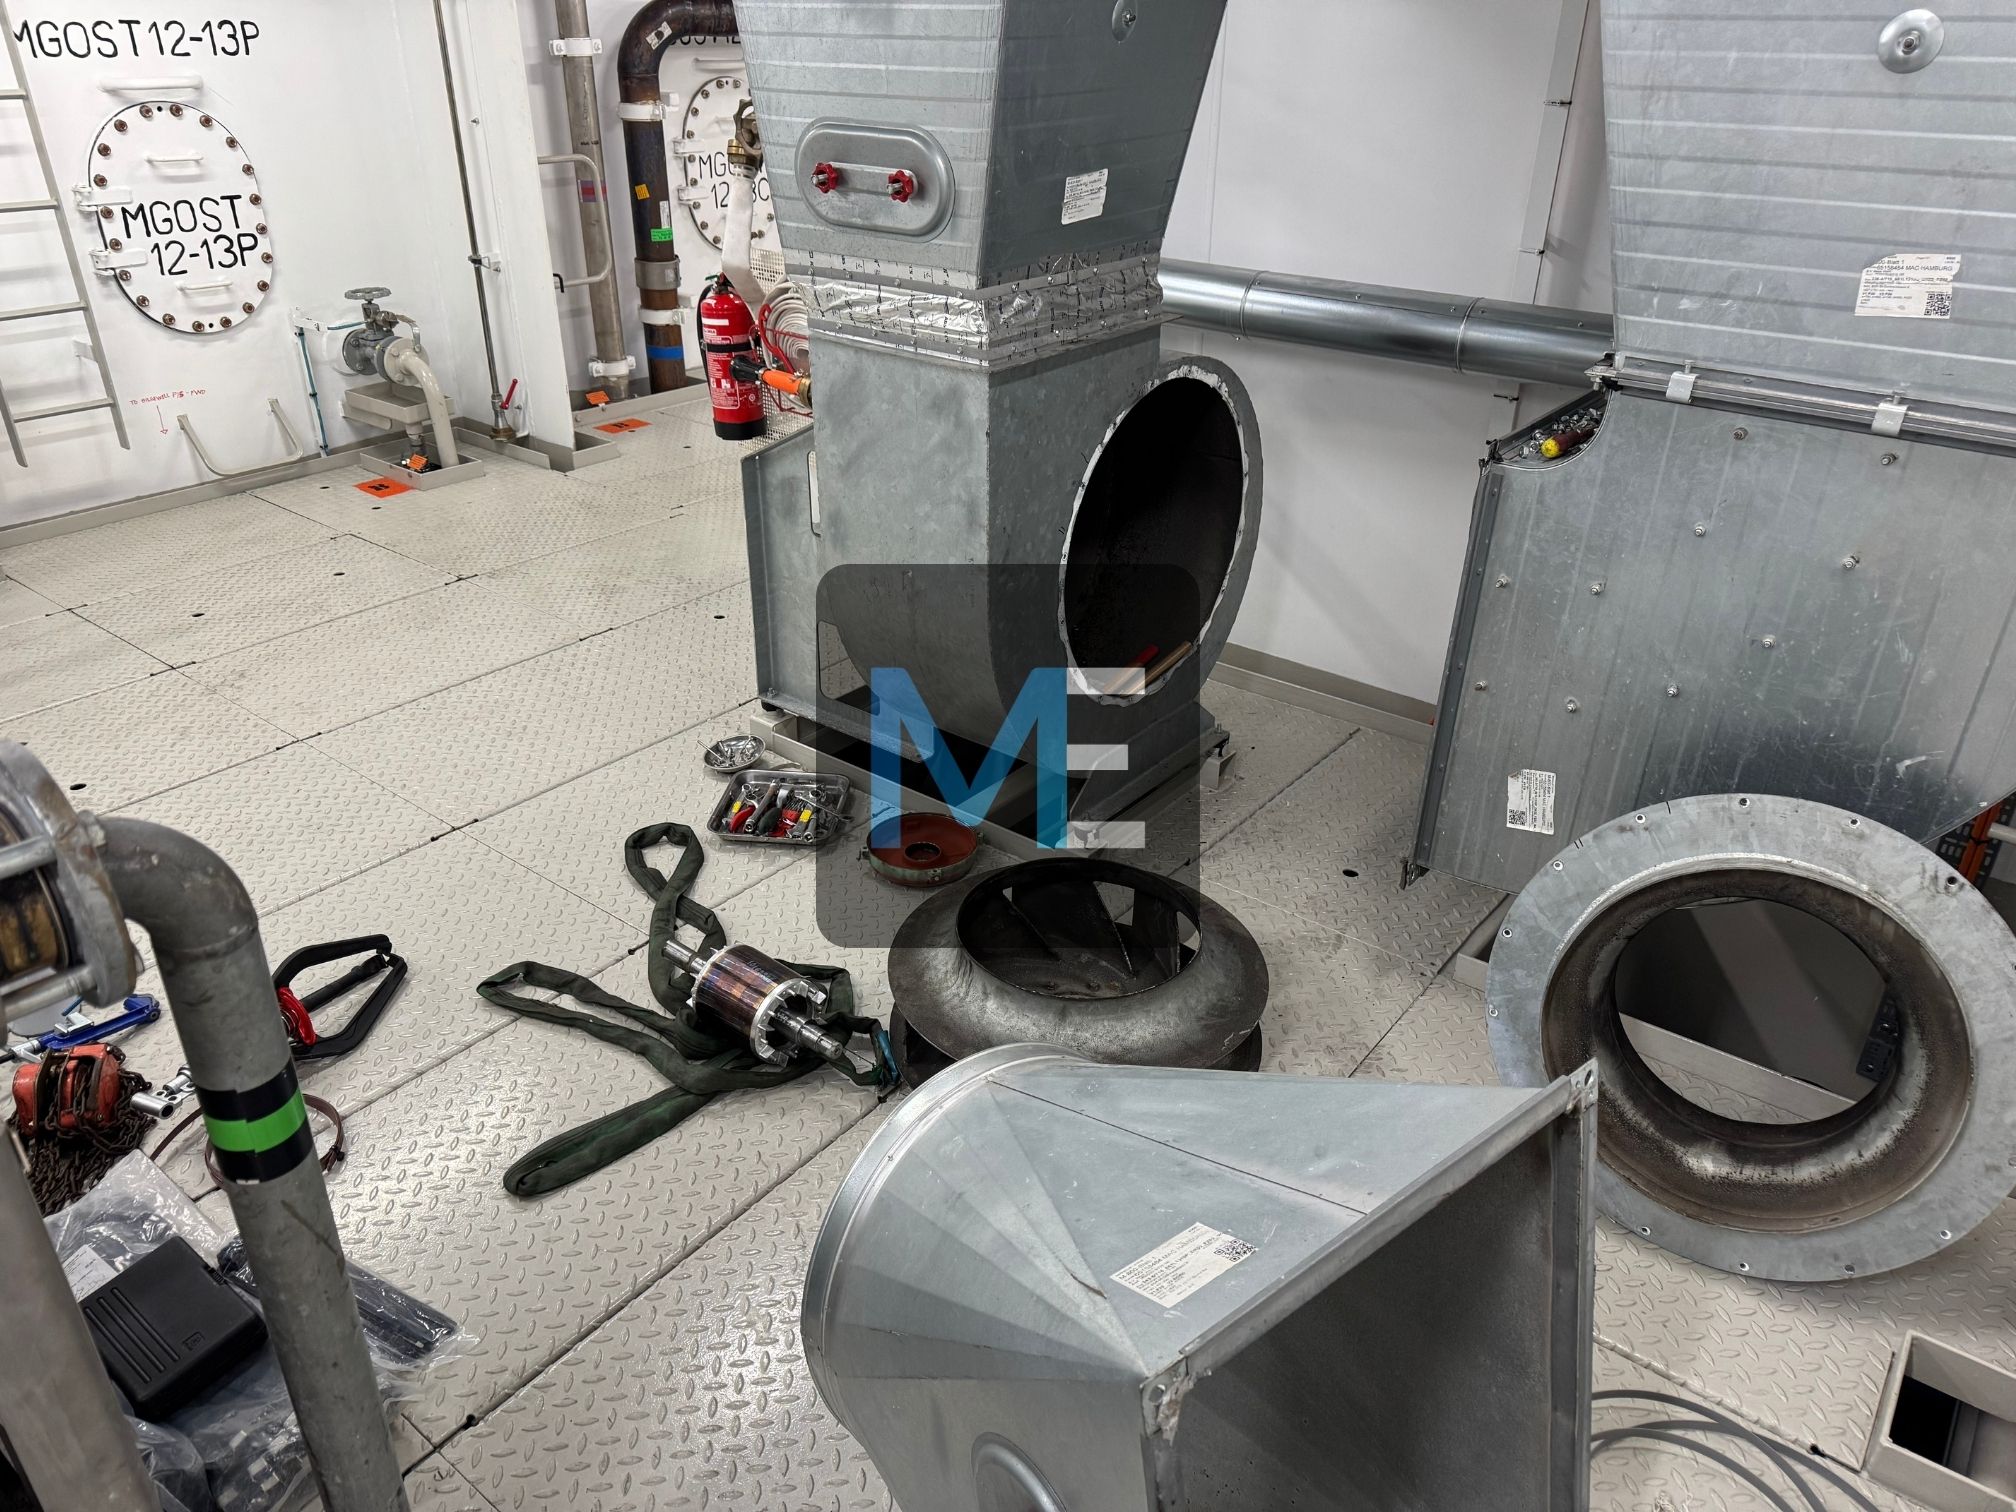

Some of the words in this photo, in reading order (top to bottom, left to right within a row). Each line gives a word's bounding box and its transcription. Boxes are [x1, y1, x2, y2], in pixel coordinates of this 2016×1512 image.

[148, 20, 260, 57] 12-13P
[121, 195, 242, 238] MGOST
[151, 233, 259, 276] 12-13P
